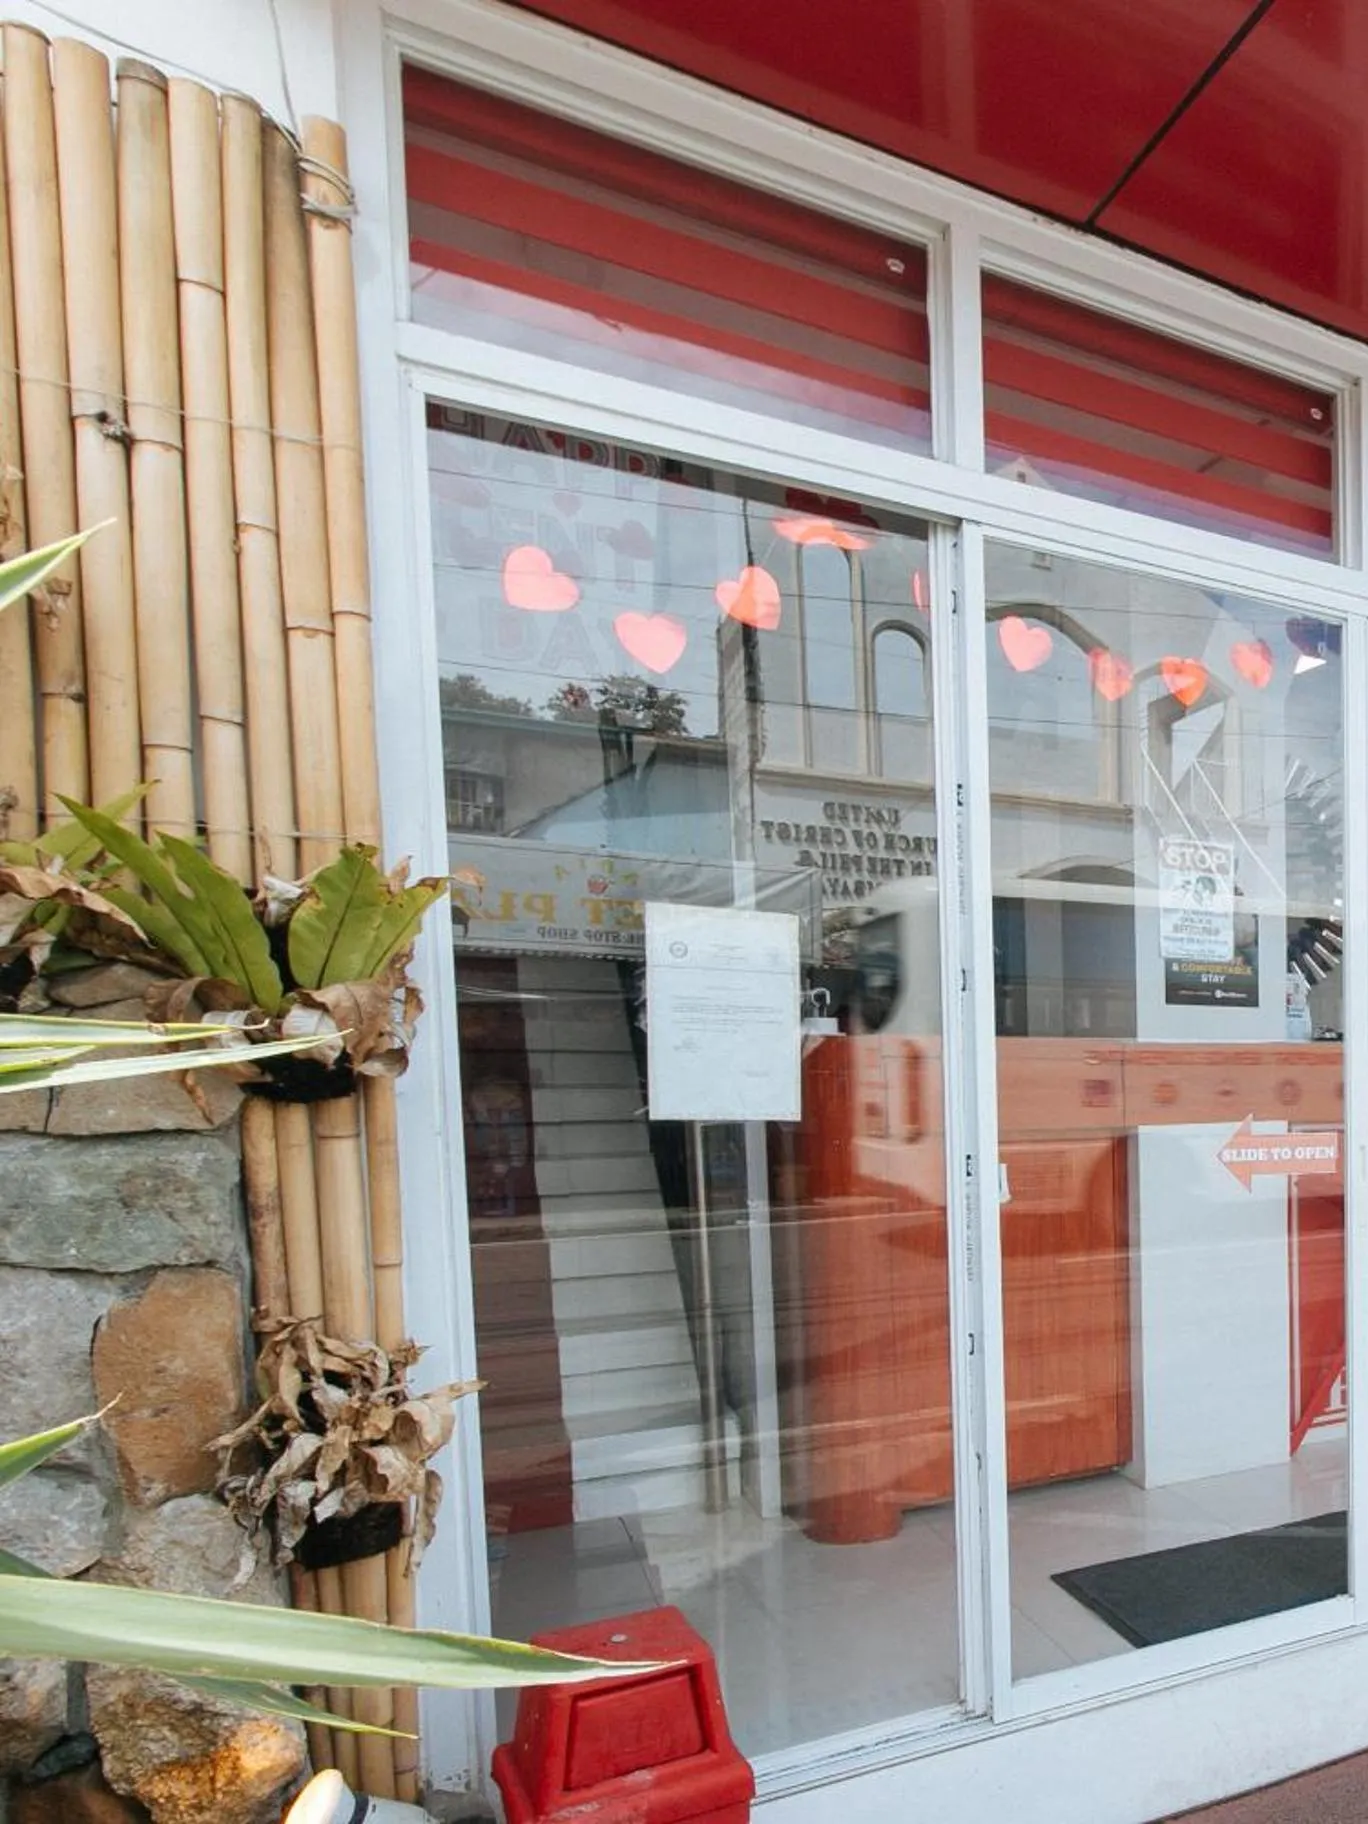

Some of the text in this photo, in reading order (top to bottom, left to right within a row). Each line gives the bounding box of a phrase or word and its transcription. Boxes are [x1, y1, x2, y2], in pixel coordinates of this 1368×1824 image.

[1164, 842, 1227, 872] STOP
[1200, 974, 1226, 983] STAY
[1221, 1145, 1335, 1163] SLIDE TO OPEN
